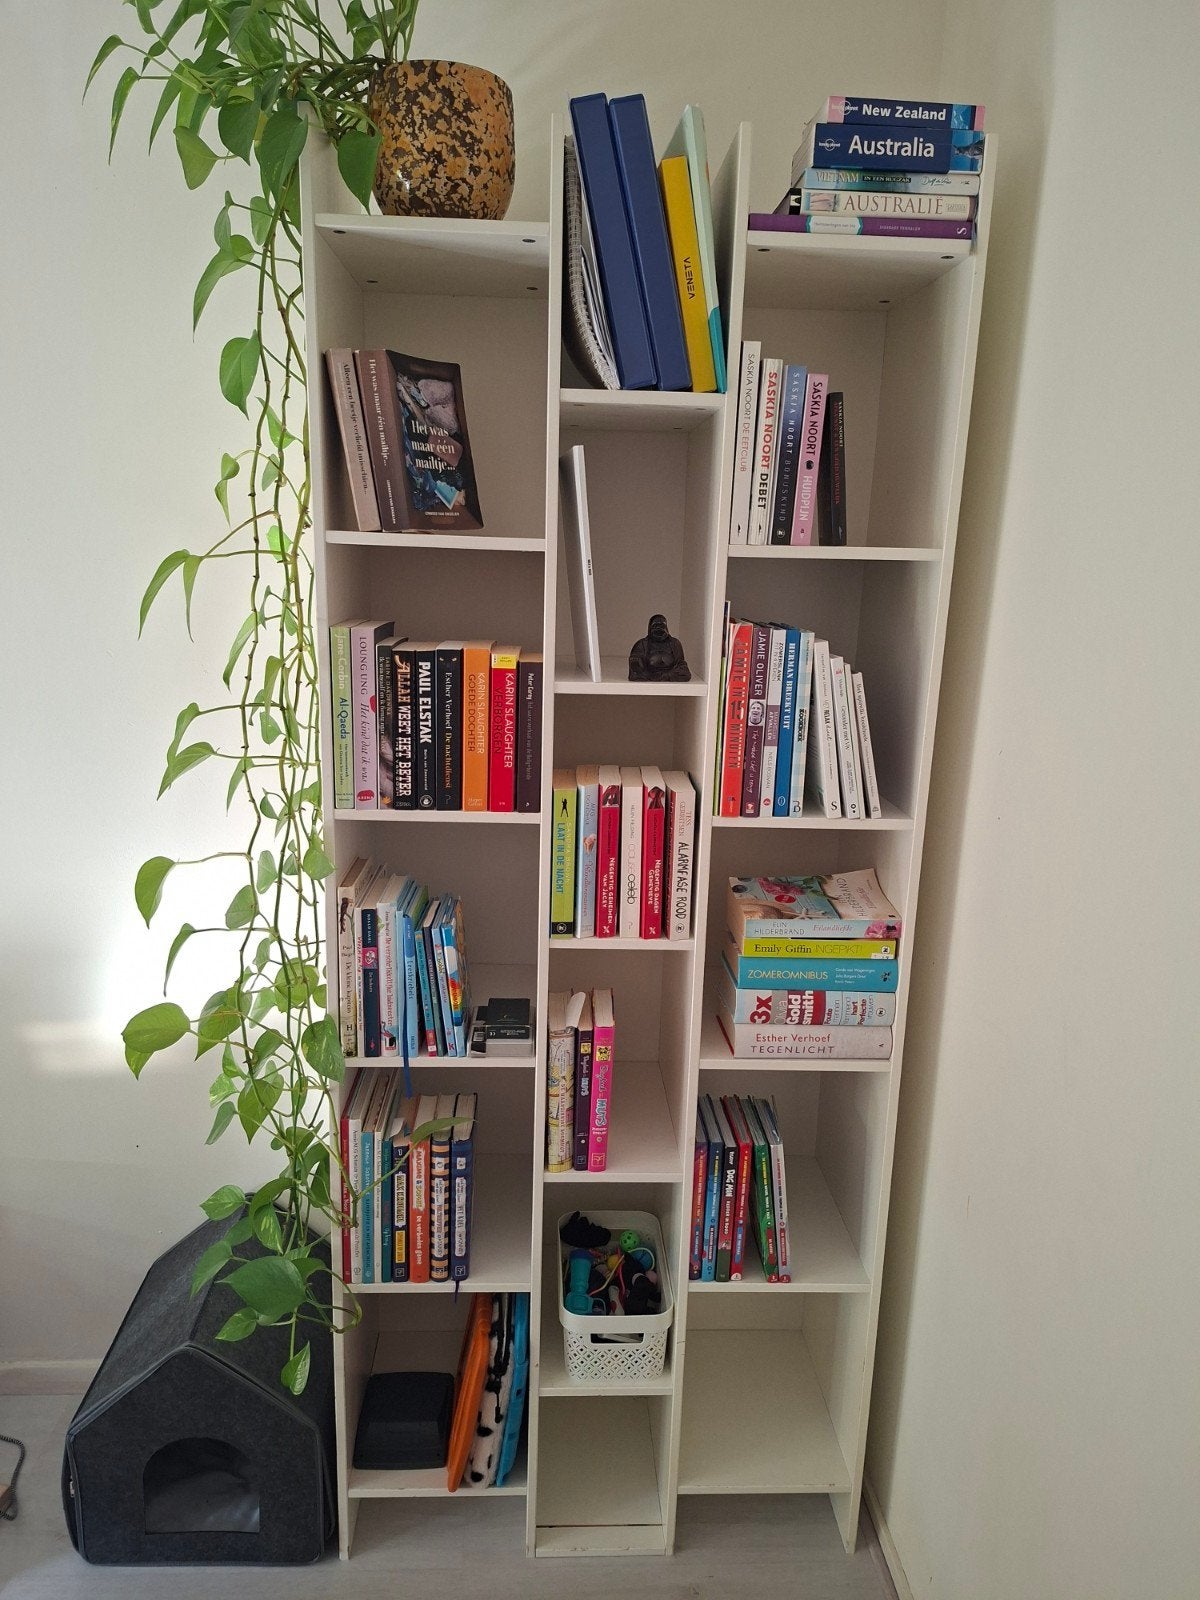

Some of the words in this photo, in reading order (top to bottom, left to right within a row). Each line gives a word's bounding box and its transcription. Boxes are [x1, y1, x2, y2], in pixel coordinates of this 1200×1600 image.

[862, 104, 892, 117] New
[895, 106, 946, 121] Zealand
[849, 135, 935, 158] Australia
[816, 170, 859, 183] VIETNAM
[844, 195, 944, 215] AUSTRALIË
[683, 257, 696, 299] VENETA
[342, 362, 351, 386] Alleen
[368, 359, 377, 374] Het
[746, 353, 755, 386] SASKIA
[370, 376, 378, 392] was
[765, 372, 778, 419] SASKIA
[789, 372, 800, 414] SASKIA
[345, 401, 357, 423] beetje
[373, 393, 382, 415] maar
[743, 388, 753, 420] NOORT
[809, 382, 822, 417] SASKIA
[375, 415, 385, 431] één
[742, 422, 750, 434] DE
[352, 424, 363, 452] verliefd
[411, 441, 434, 454] maar
[761, 424, 773, 469] NOORT
[786, 420, 794, 454] NOORT
[806, 420, 818, 455] NOORT
[740, 436, 749, 472] EETCLUB
[757, 473, 769, 510] DEBET
[779, 460, 792, 521] BONUSKIND
[799, 475, 813, 521] HUIDPIJN
[335, 634, 346, 656] Jane
[359, 637, 367, 671] LOUNG
[757, 631, 765, 660] JAMIE
[337, 657, 347, 690] Corbin
[733, 638, 748, 682] JAMIE
[787, 642, 795, 680] HERMAN
[360, 673, 368, 695] UNG
[394, 655, 411, 702] ALLAH
[418, 662, 431, 694] PAUL
[445, 672, 453, 698] Esther
[468, 674, 476, 706] GOEDE
[477, 672, 485, 700] KARIN
[505, 673, 513, 706] KARIN
[754, 663, 765, 696] OLIVER
[732, 687, 745, 697] IN
[785, 680, 793, 713] BREEKT
[337, 697, 349, 740] Al-Qaeda
[360, 702, 369, 719] Het
[399, 706, 411, 735] WEET
[419, 697, 432, 744] ELSTAK
[445, 699, 453, 730] Verhoef
[494, 687, 502, 754] VERBORGEN
[783, 715, 792, 729] UIT
[361, 721, 370, 740] kind
[445, 732, 452, 743] De
[468, 708, 476, 752] DOCHTER
[477, 702, 485, 754] SLAUGHTER
[504, 708, 513, 768] SLAUGHTER
[362, 741, 371, 754] dat
[398, 737, 411, 759] HET
[728, 723, 743, 769] MINUTEN
[362, 756, 371, 765] ik
[399, 762, 411, 797] BETER
[678, 801, 686, 836] GERRITSEN
[557, 823, 565, 842] LAAT
[557, 844, 565, 852] IN
[557, 855, 564, 866] DE
[556, 868, 564, 893] NACHT
[676, 842, 689, 892] ALARMFASE
[627, 874, 637, 905] celeb
[675, 896, 687, 919] ROOD
[385, 937, 392, 945] De
[754, 944, 781, 955] Emily
[785, 944, 812, 954] Giffin
[747, 969, 828, 980] ZOMEROMNIBUS
[750, 996, 772, 1023] 3x
[787, 995, 801, 1024] Gold
[802, 991, 814, 1025] smith
[824, 1008, 833, 1024] Foute
[850, 1001, 858, 1015] hart
[858, 999, 867, 1025] Perfecte
[750, 1045, 835, 1054] TEGENLICHT
[756, 1034, 788, 1042] Esther
[791, 1034, 831, 1042] Verhoef
[581, 1078, 589, 1096] MUTS
[596, 1099, 607, 1126] MUTS
[396, 1175, 405, 1189] MAX
[726, 1170, 736, 1183] DOG
[725, 1184, 735, 1197] MAN
